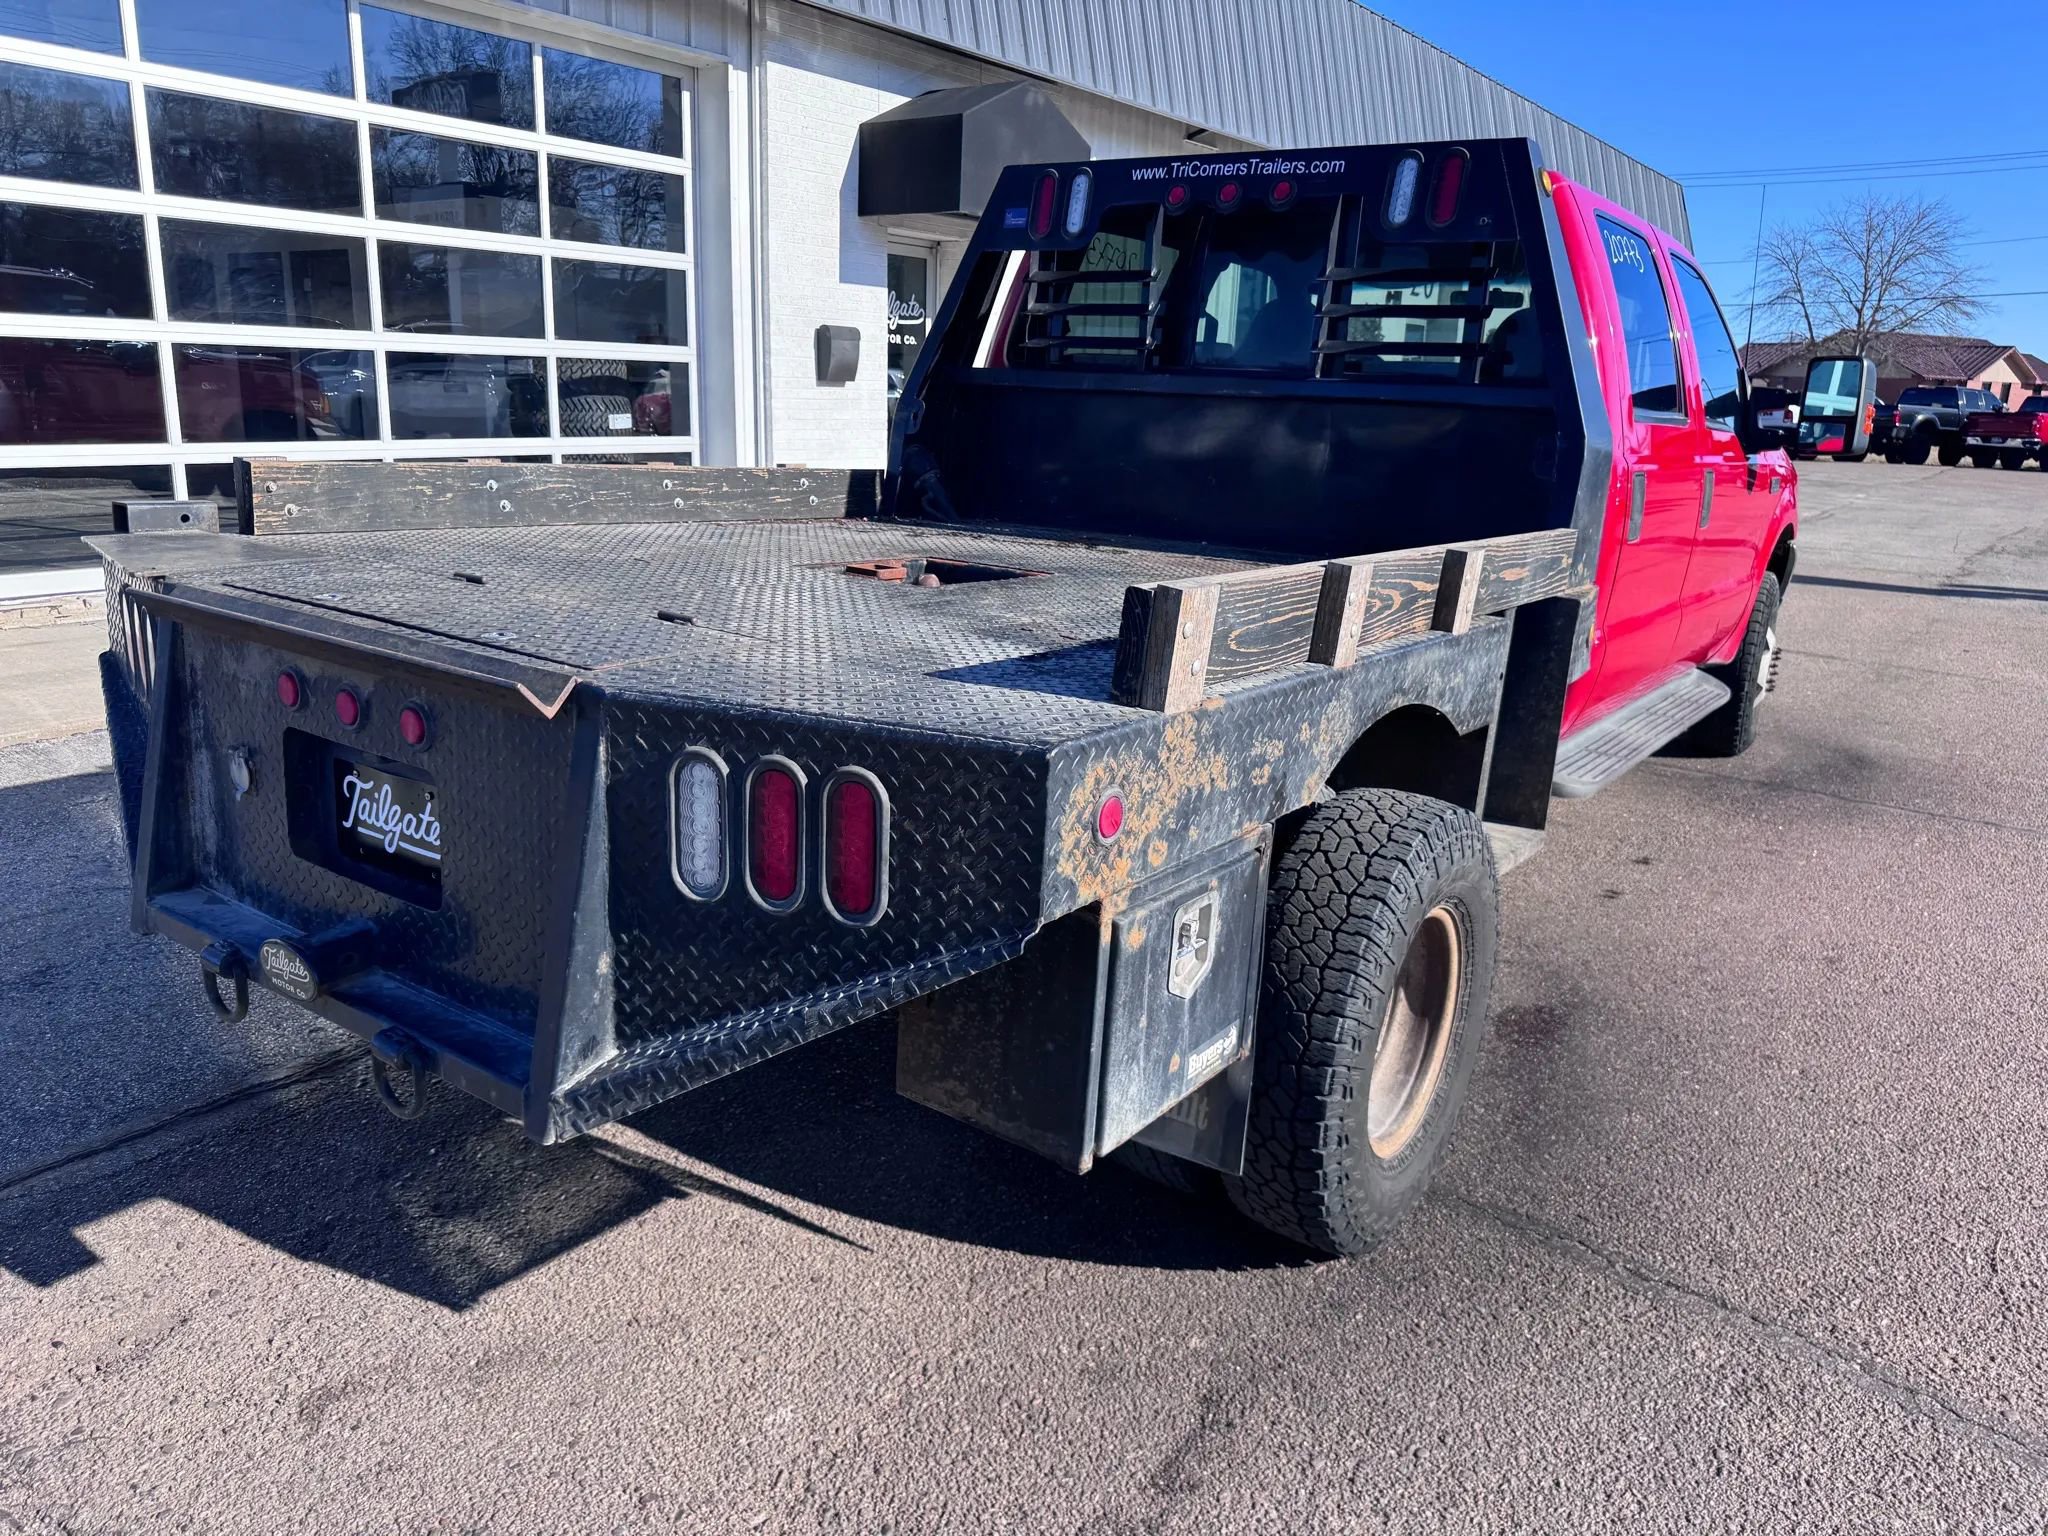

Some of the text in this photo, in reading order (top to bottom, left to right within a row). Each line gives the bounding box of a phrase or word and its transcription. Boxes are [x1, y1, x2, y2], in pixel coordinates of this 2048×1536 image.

[1131, 158, 1345, 181] www.TriCornersTrailers.com
[1603, 229, 1644, 273] 20773
[888, 290, 925, 330] lgate
[342, 774, 441, 855] Tailgate
[263, 946, 310, 982] Tailgate
[271, 976, 296, 993] MOTOR
[1188, 1039, 1224, 1073] Buyers
